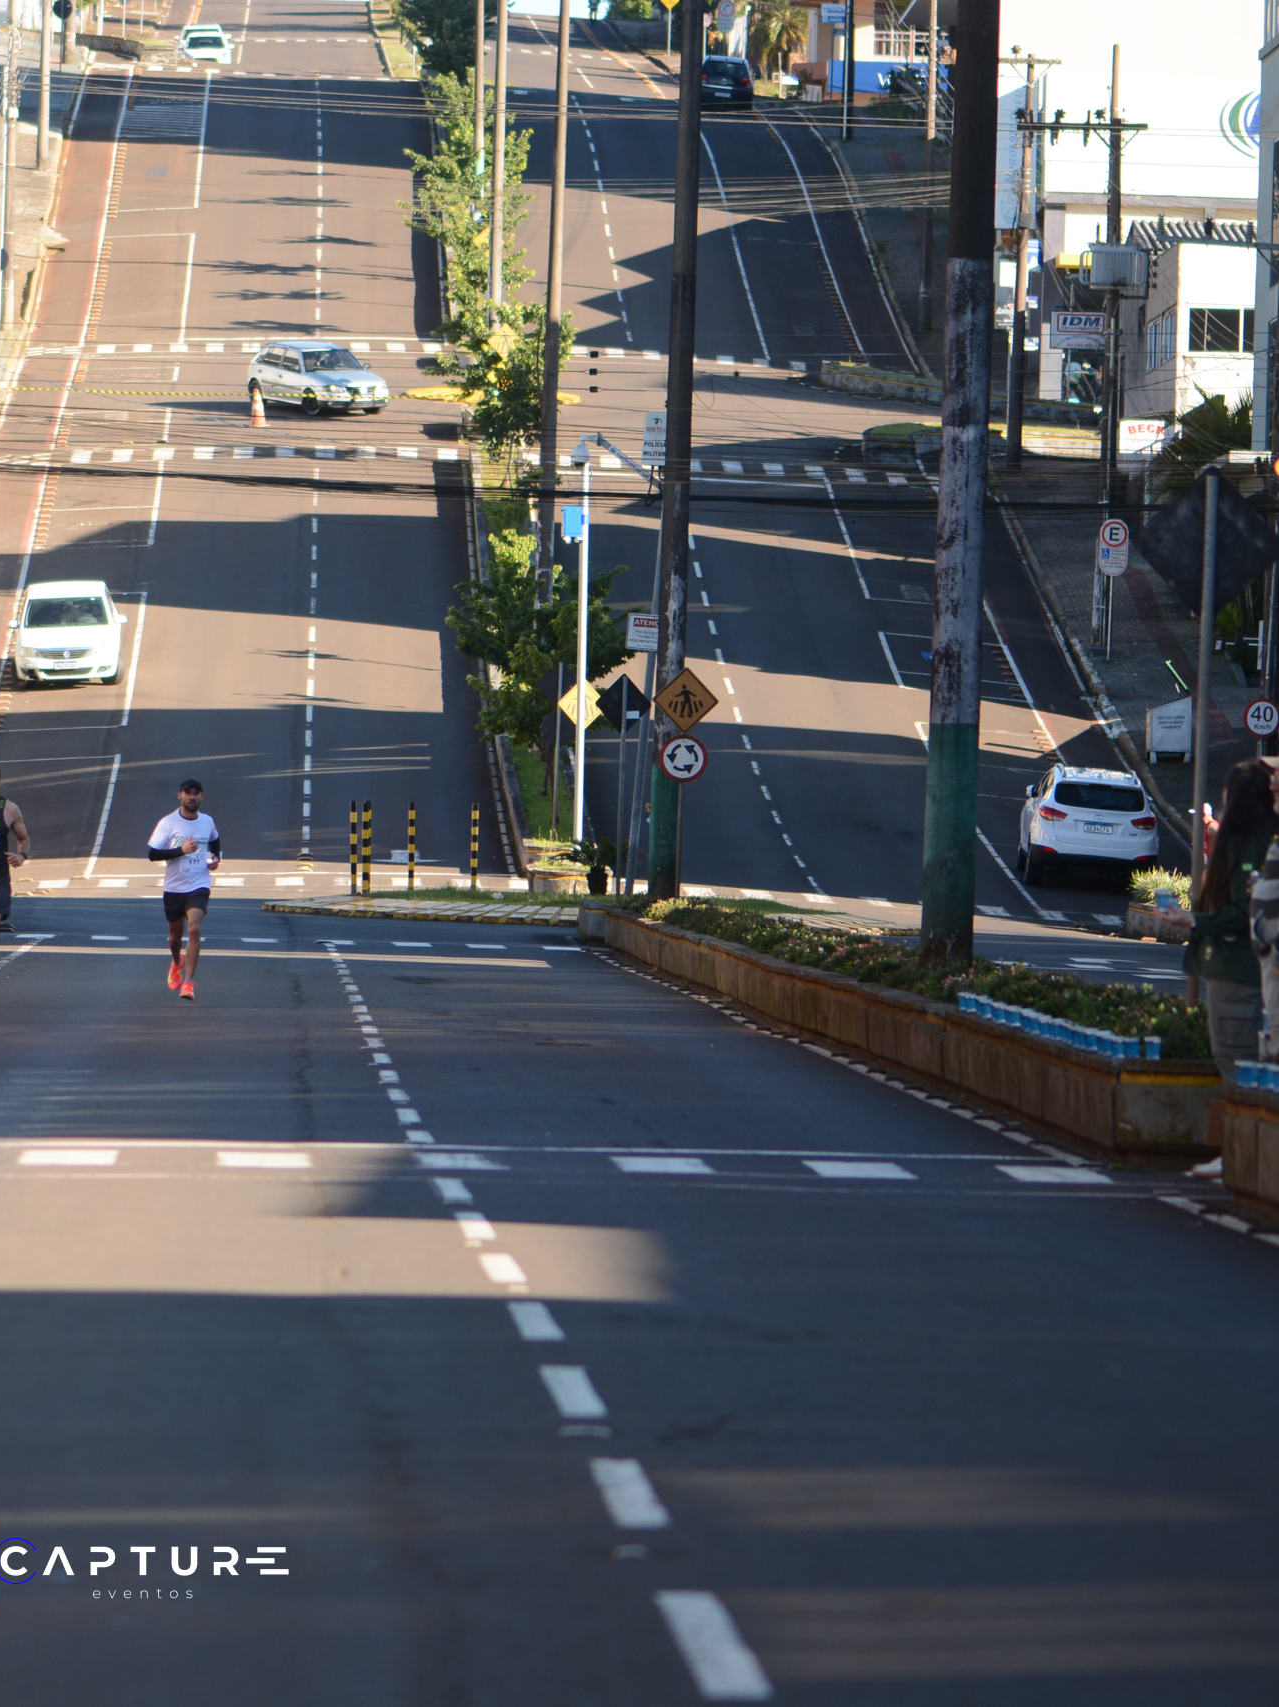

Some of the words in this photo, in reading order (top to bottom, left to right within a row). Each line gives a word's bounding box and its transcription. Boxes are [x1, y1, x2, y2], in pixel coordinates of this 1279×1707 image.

[1062, 316, 1101, 327] IDM
[1109, 527, 1120, 541] E
[1250, 705, 1274, 723] 40
